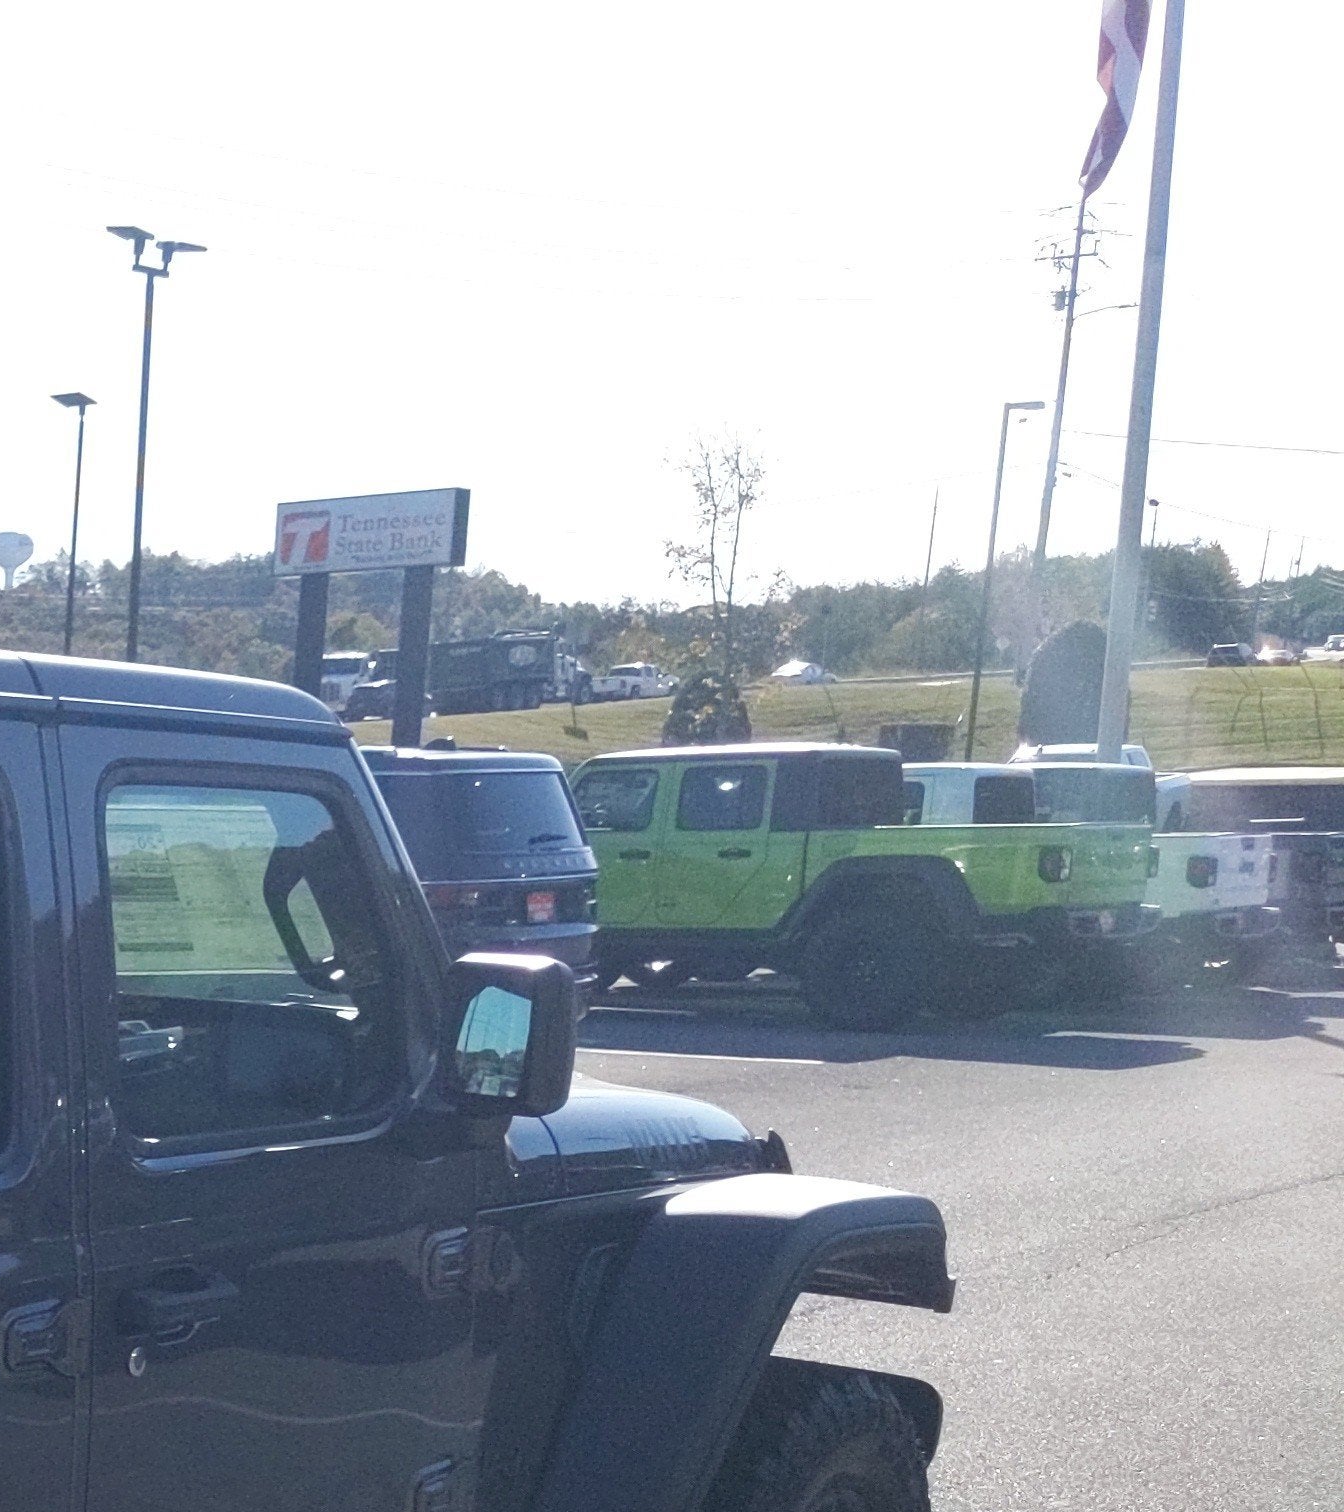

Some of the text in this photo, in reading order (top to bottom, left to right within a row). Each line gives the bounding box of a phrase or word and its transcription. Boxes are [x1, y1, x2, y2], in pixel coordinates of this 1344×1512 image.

[337, 511, 447, 533] Tennessee
[335, 530, 443, 555] State Bank
